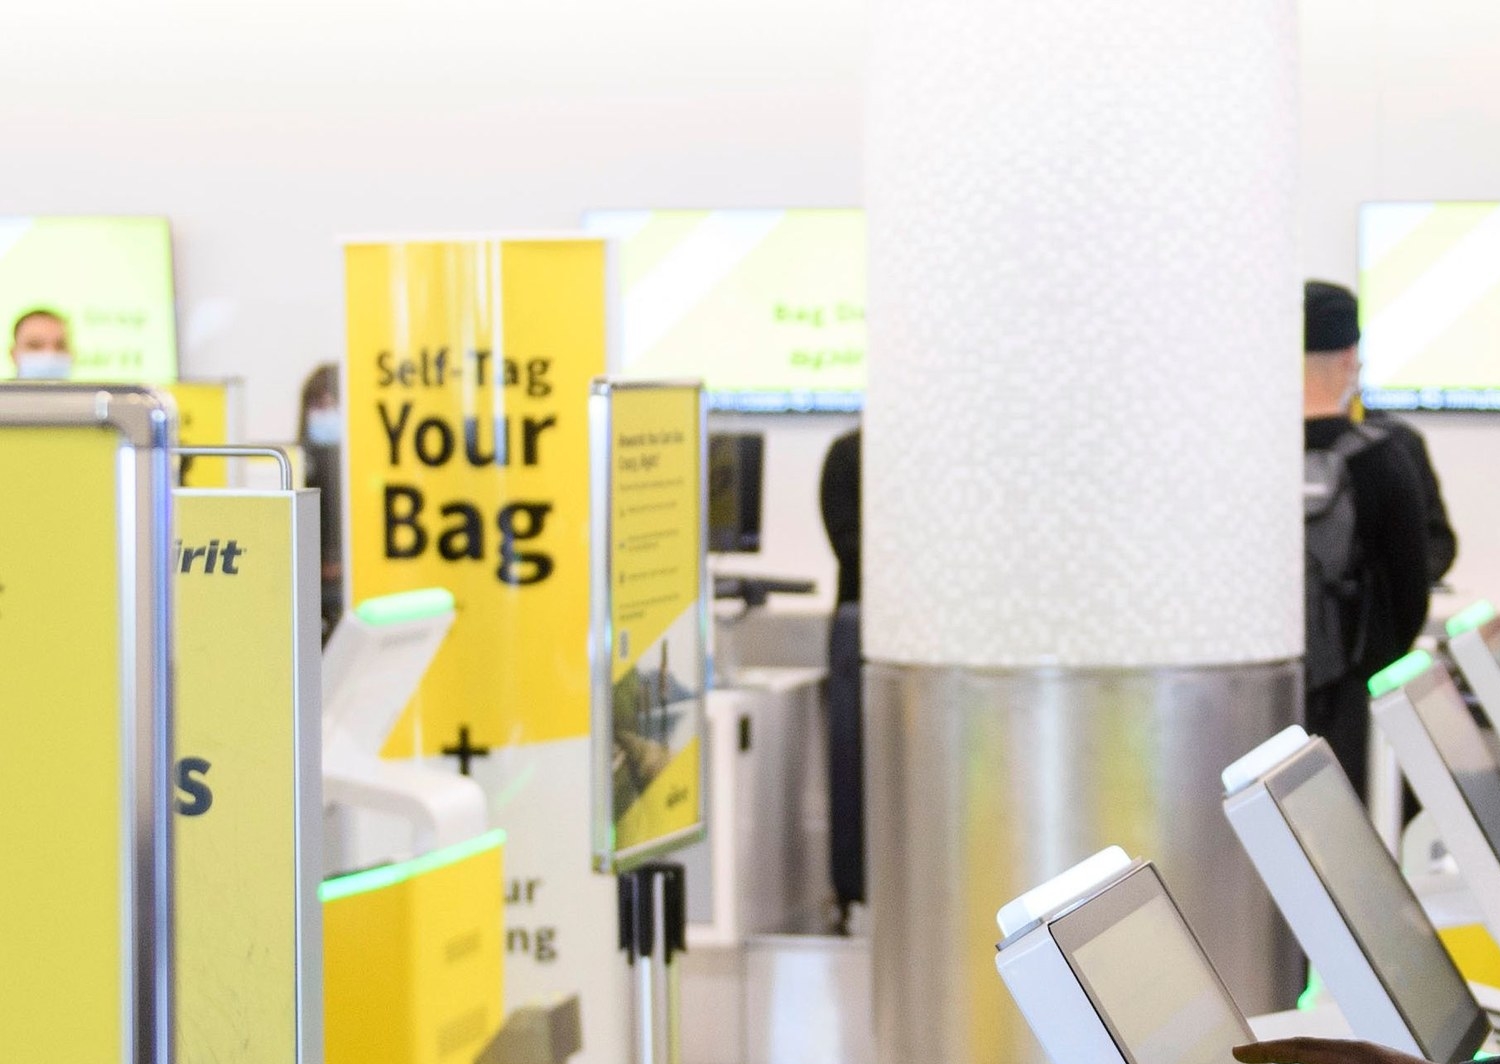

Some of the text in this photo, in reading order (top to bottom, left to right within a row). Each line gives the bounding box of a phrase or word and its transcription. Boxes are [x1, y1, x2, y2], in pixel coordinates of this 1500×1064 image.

[377, 348, 552, 398] Self-Tag
[378, 402, 557, 467] Your
[384, 485, 554, 585] Bag
